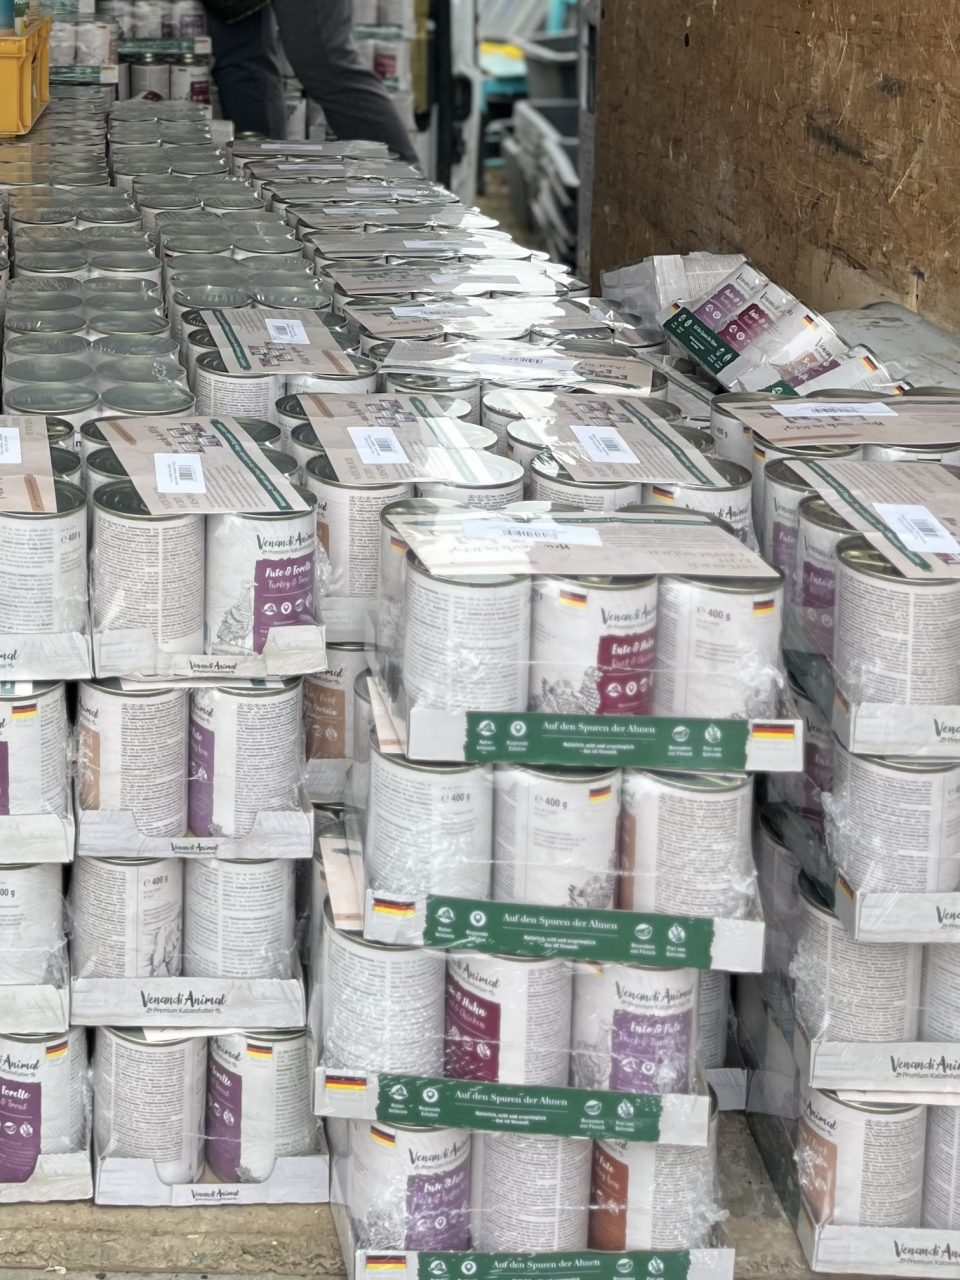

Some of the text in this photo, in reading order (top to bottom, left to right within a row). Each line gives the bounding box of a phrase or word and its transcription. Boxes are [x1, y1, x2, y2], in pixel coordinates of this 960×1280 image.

[256, 534, 294, 550] Venandi
[601, 608, 640, 624] Venandi
[708, 609, 724, 619] 400
[543, 721, 655, 735] Auf den Spuren der Ahnen
[452, 793, 464, 802] 400
[545, 798, 560, 808] 400
[10, 889, 15, 898] g
[503, 914, 618, 930] Auf den Spuren der Ahnen
[463, 963, 500, 990] Animal
[140, 990, 226, 1008] Venandi Animal
[616, 981, 660, 1002] Venandi
[2, 1054, 40, 1070] Animal
[890, 1055, 937, 1072] Venandi
[1, 1084, 31, 1100] Forelle
[455, 1091, 568, 1106] Auf den Spuren der Ahnen
[408, 1148, 450, 1165] Venandi
[894, 1240, 940, 1258] Venandi
[494, 1260, 508, 1268] Auf
[527, 1260, 556, 1270] Spuren
[574, 1259, 600, 1267] Ahnen
